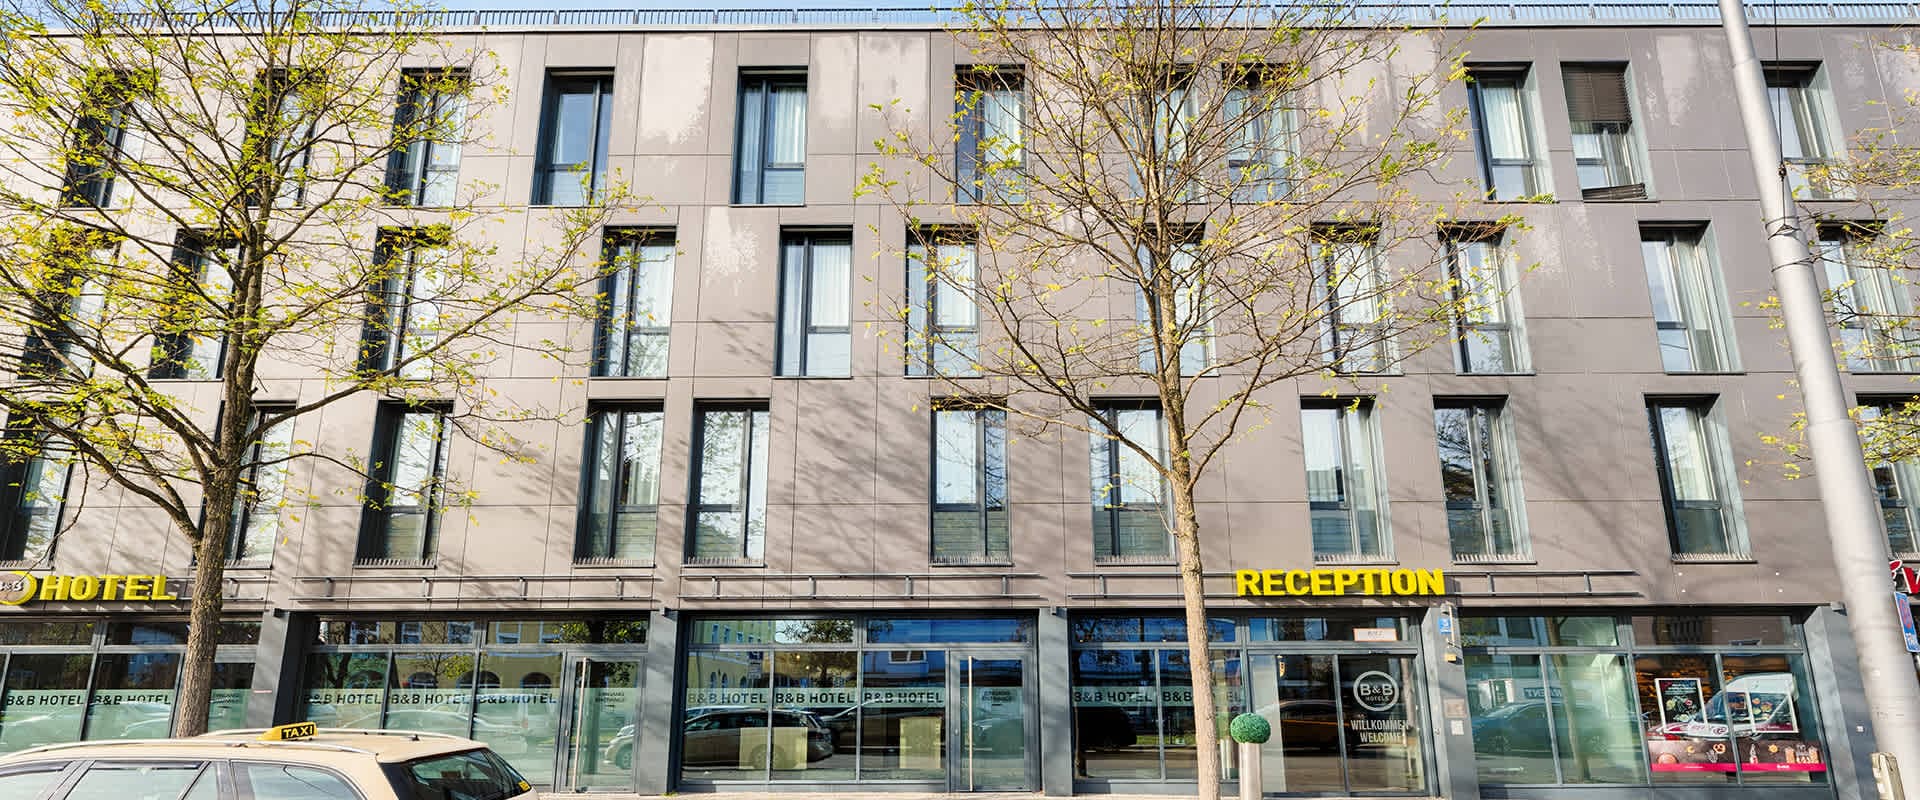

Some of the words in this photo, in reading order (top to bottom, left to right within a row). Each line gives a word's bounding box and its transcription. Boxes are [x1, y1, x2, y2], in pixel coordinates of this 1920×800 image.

[1235, 568, 1446, 596] RECEPTION
[39, 575, 177, 601] HOTEL
[1360, 683, 1393, 696] B&B
[7, 695, 35, 706] B&B
[39, 695, 85, 706] HOTEL
[336, 694, 383, 705] HOTEL
[391, 694, 420, 704] B&B
[512, 693, 556, 704] HOTEL
[688, 693, 717, 704] B&B
[722, 693, 768, 704] HOTEL
[775, 693, 805, 704] B&B
[809, 693, 855, 704] HOTEL
[898, 692, 942, 704] HOTEL
[1107, 691, 1152, 702] HOTEL
[1163, 691, 1193, 702] B&B
[1350, 719, 1409, 731] WILLKOMMEN
[283, 726, 313, 738] TAXI
[1360, 731, 1402, 743] WELCOME
